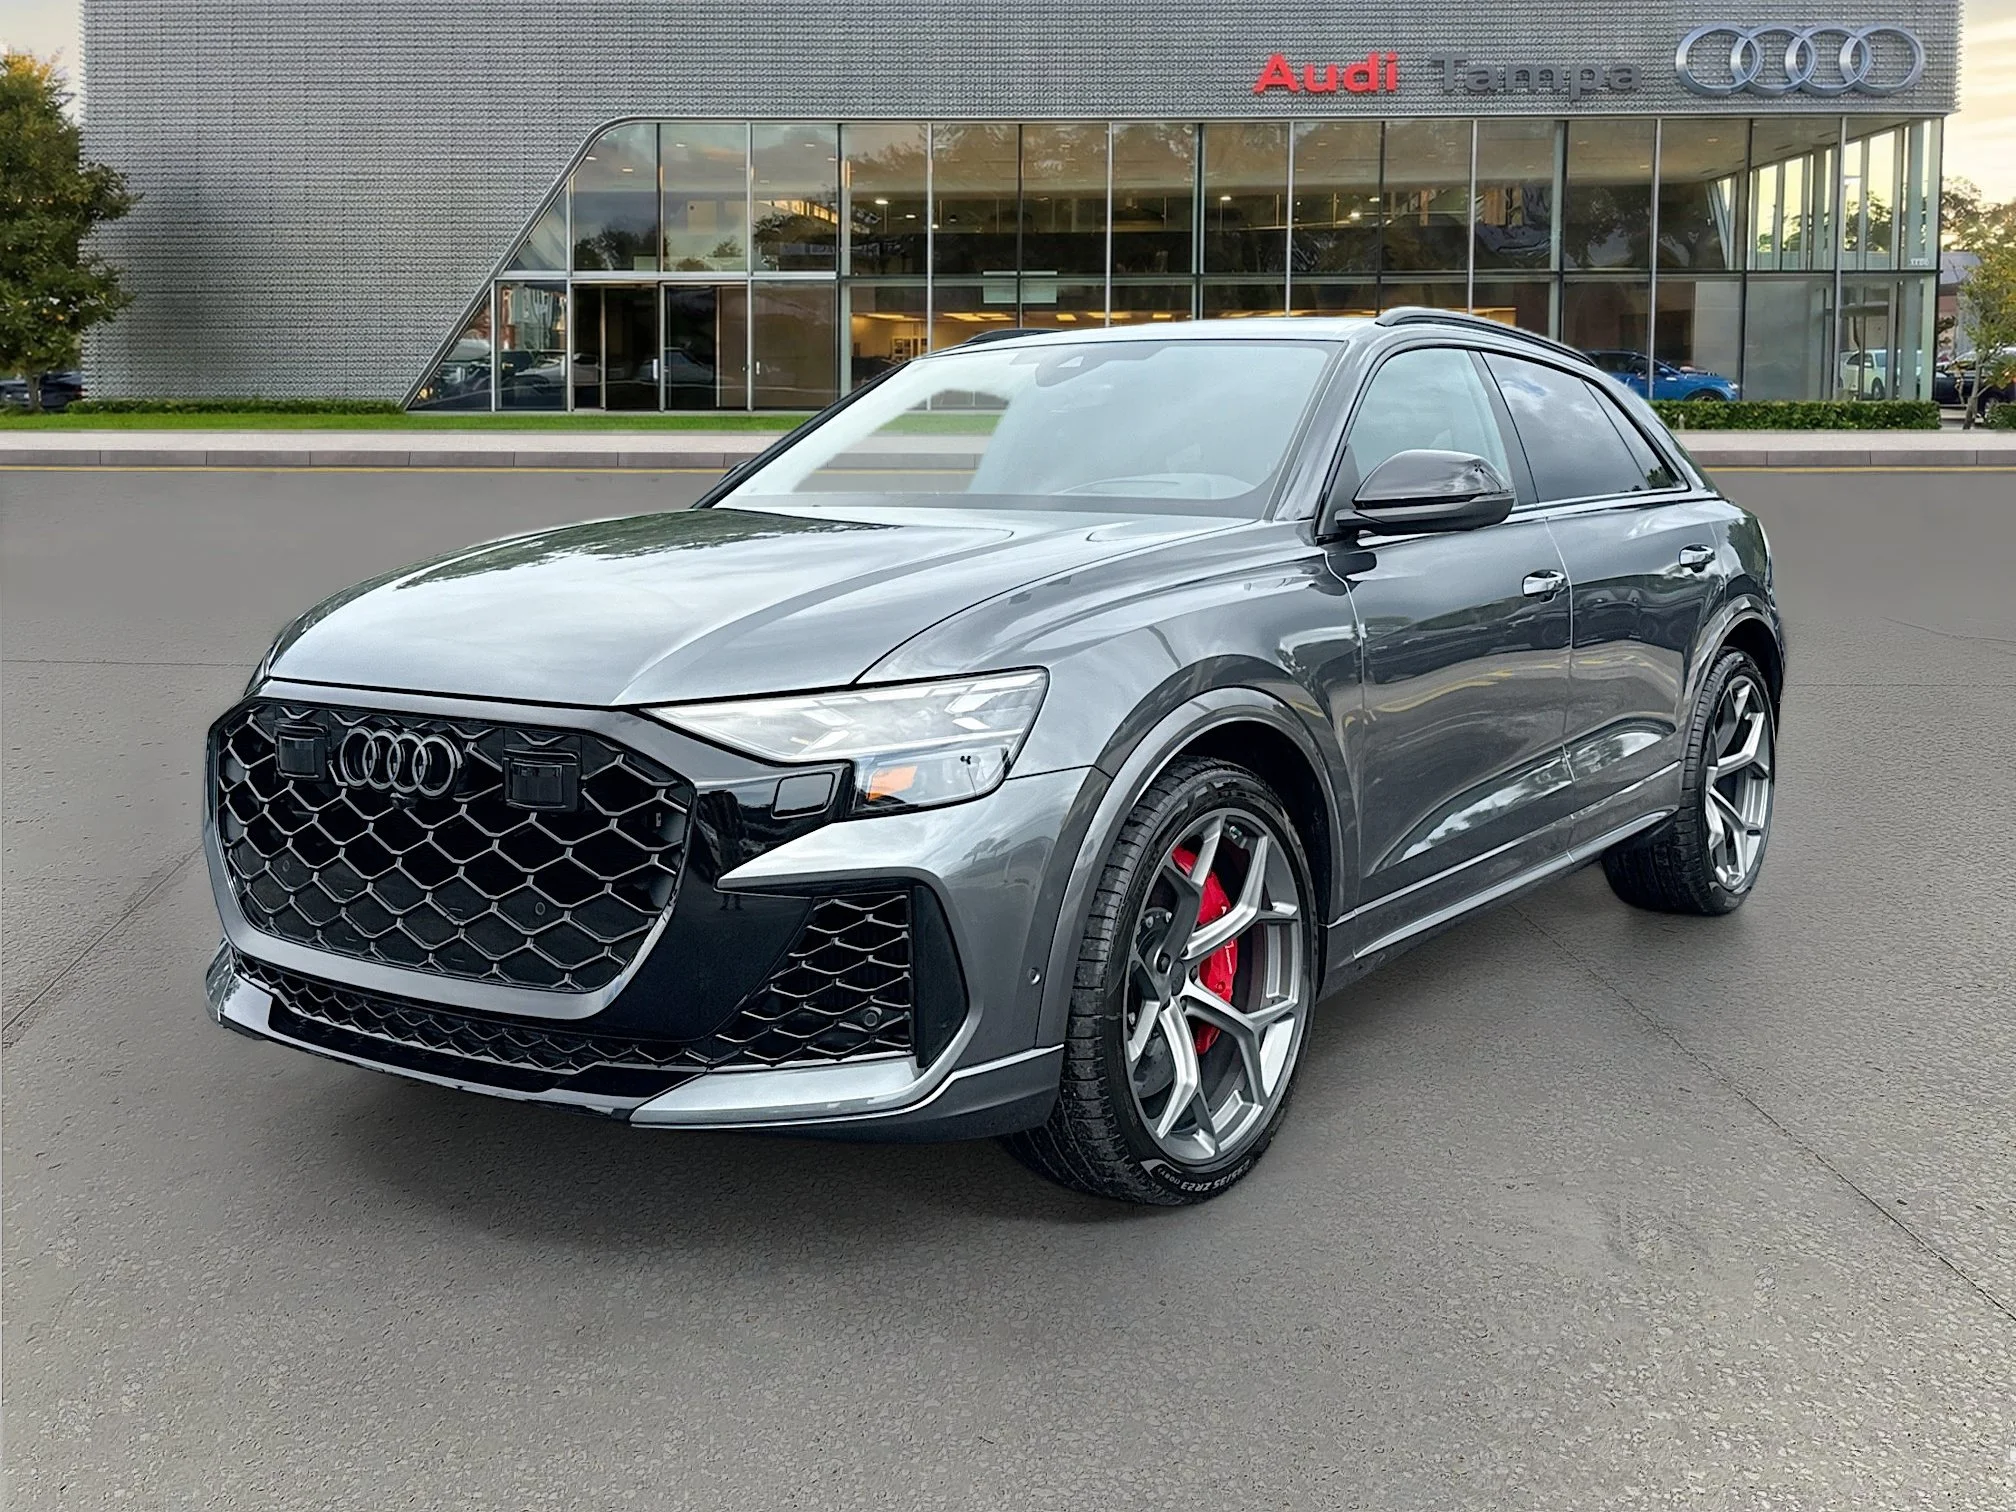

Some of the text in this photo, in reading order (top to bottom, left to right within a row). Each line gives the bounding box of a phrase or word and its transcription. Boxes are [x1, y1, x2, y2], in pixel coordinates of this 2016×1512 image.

[1253, 51, 1644, 101] Audi Tampa
[1180, 1181, 1213, 1192] ZR23
